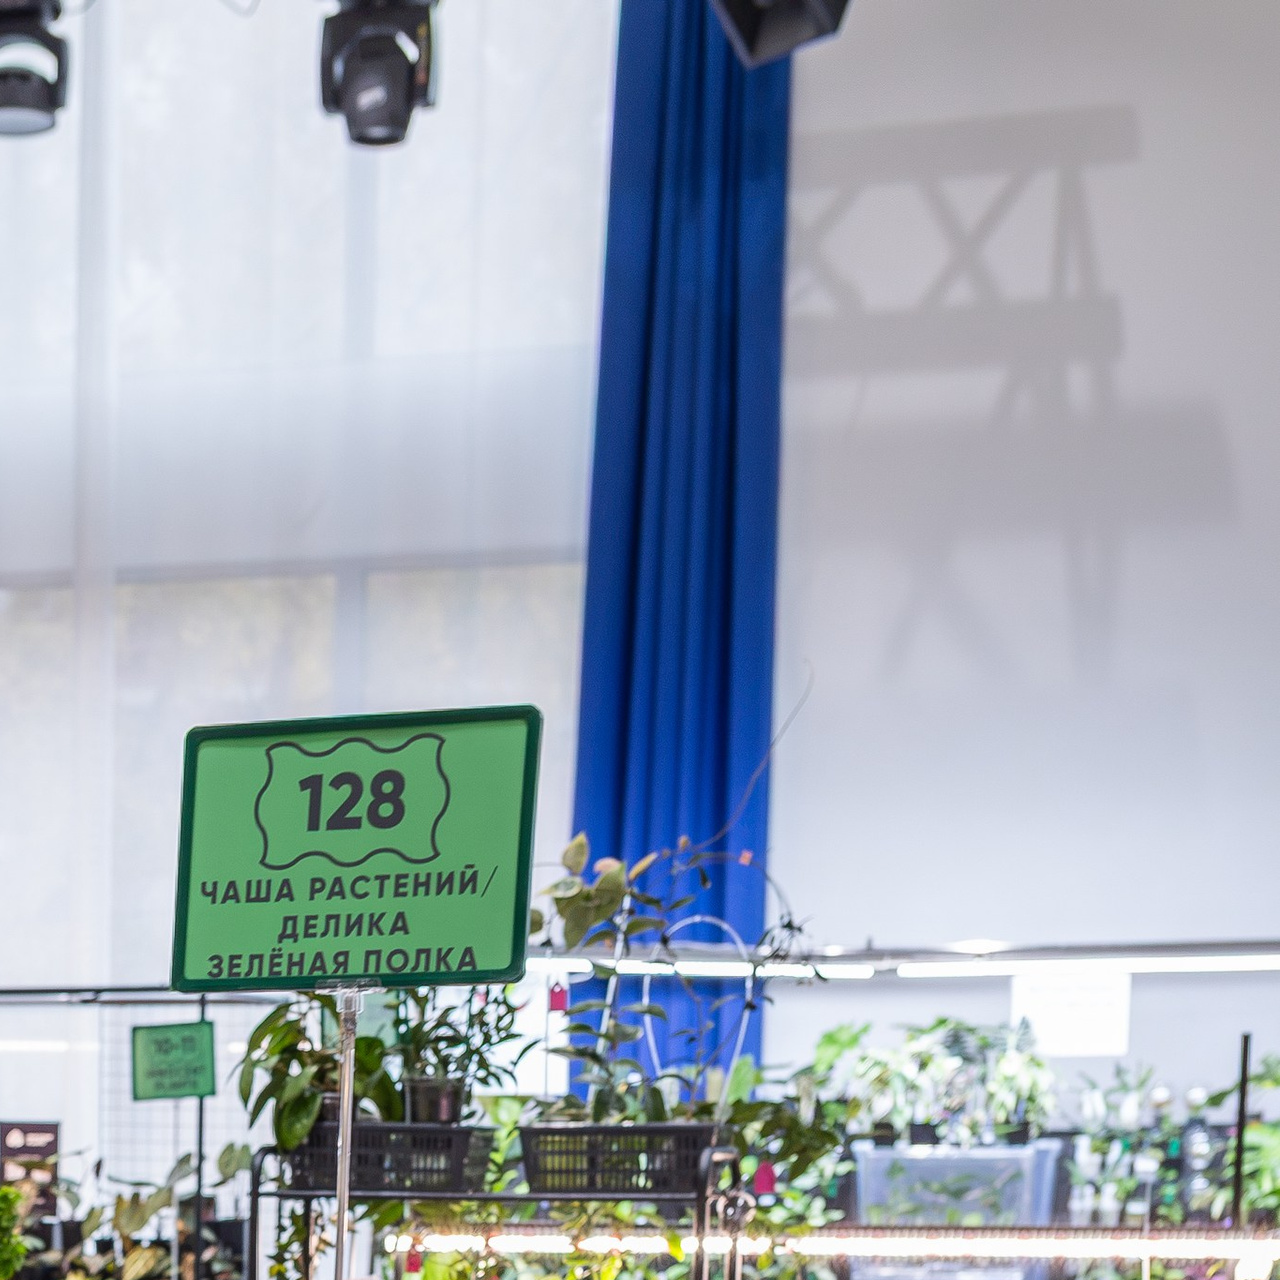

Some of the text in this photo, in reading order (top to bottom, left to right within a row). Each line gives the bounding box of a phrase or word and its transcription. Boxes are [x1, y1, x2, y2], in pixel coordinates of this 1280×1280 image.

[298, 769, 406, 832] 128
[200, 877, 296, 904] ЧАША
[277, 911, 411, 943] ДЕЛИКА
[206, 946, 478, 978] ЗЕЛЁНАЯ ПОЛКА
